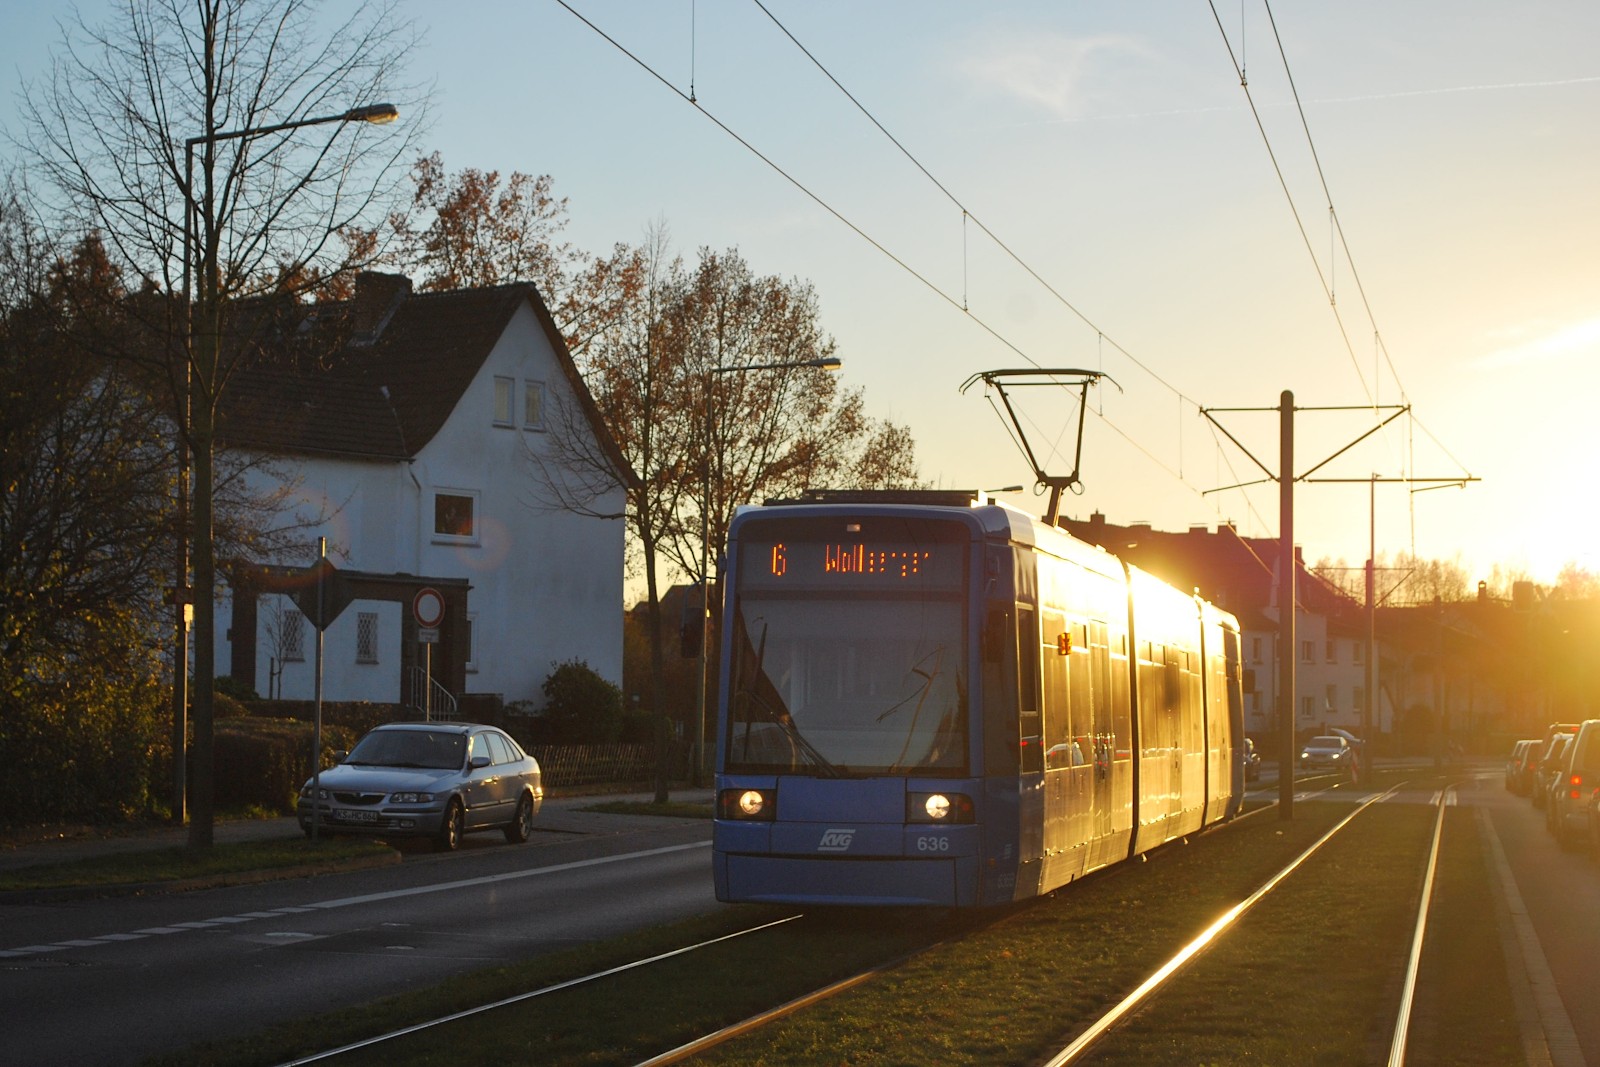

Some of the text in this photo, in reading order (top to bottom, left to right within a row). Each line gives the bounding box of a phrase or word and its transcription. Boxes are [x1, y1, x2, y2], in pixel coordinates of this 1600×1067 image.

[771, 543, 787, 577] 6
[818, 833, 853, 847] KVG
[916, 836, 950, 851] 636
